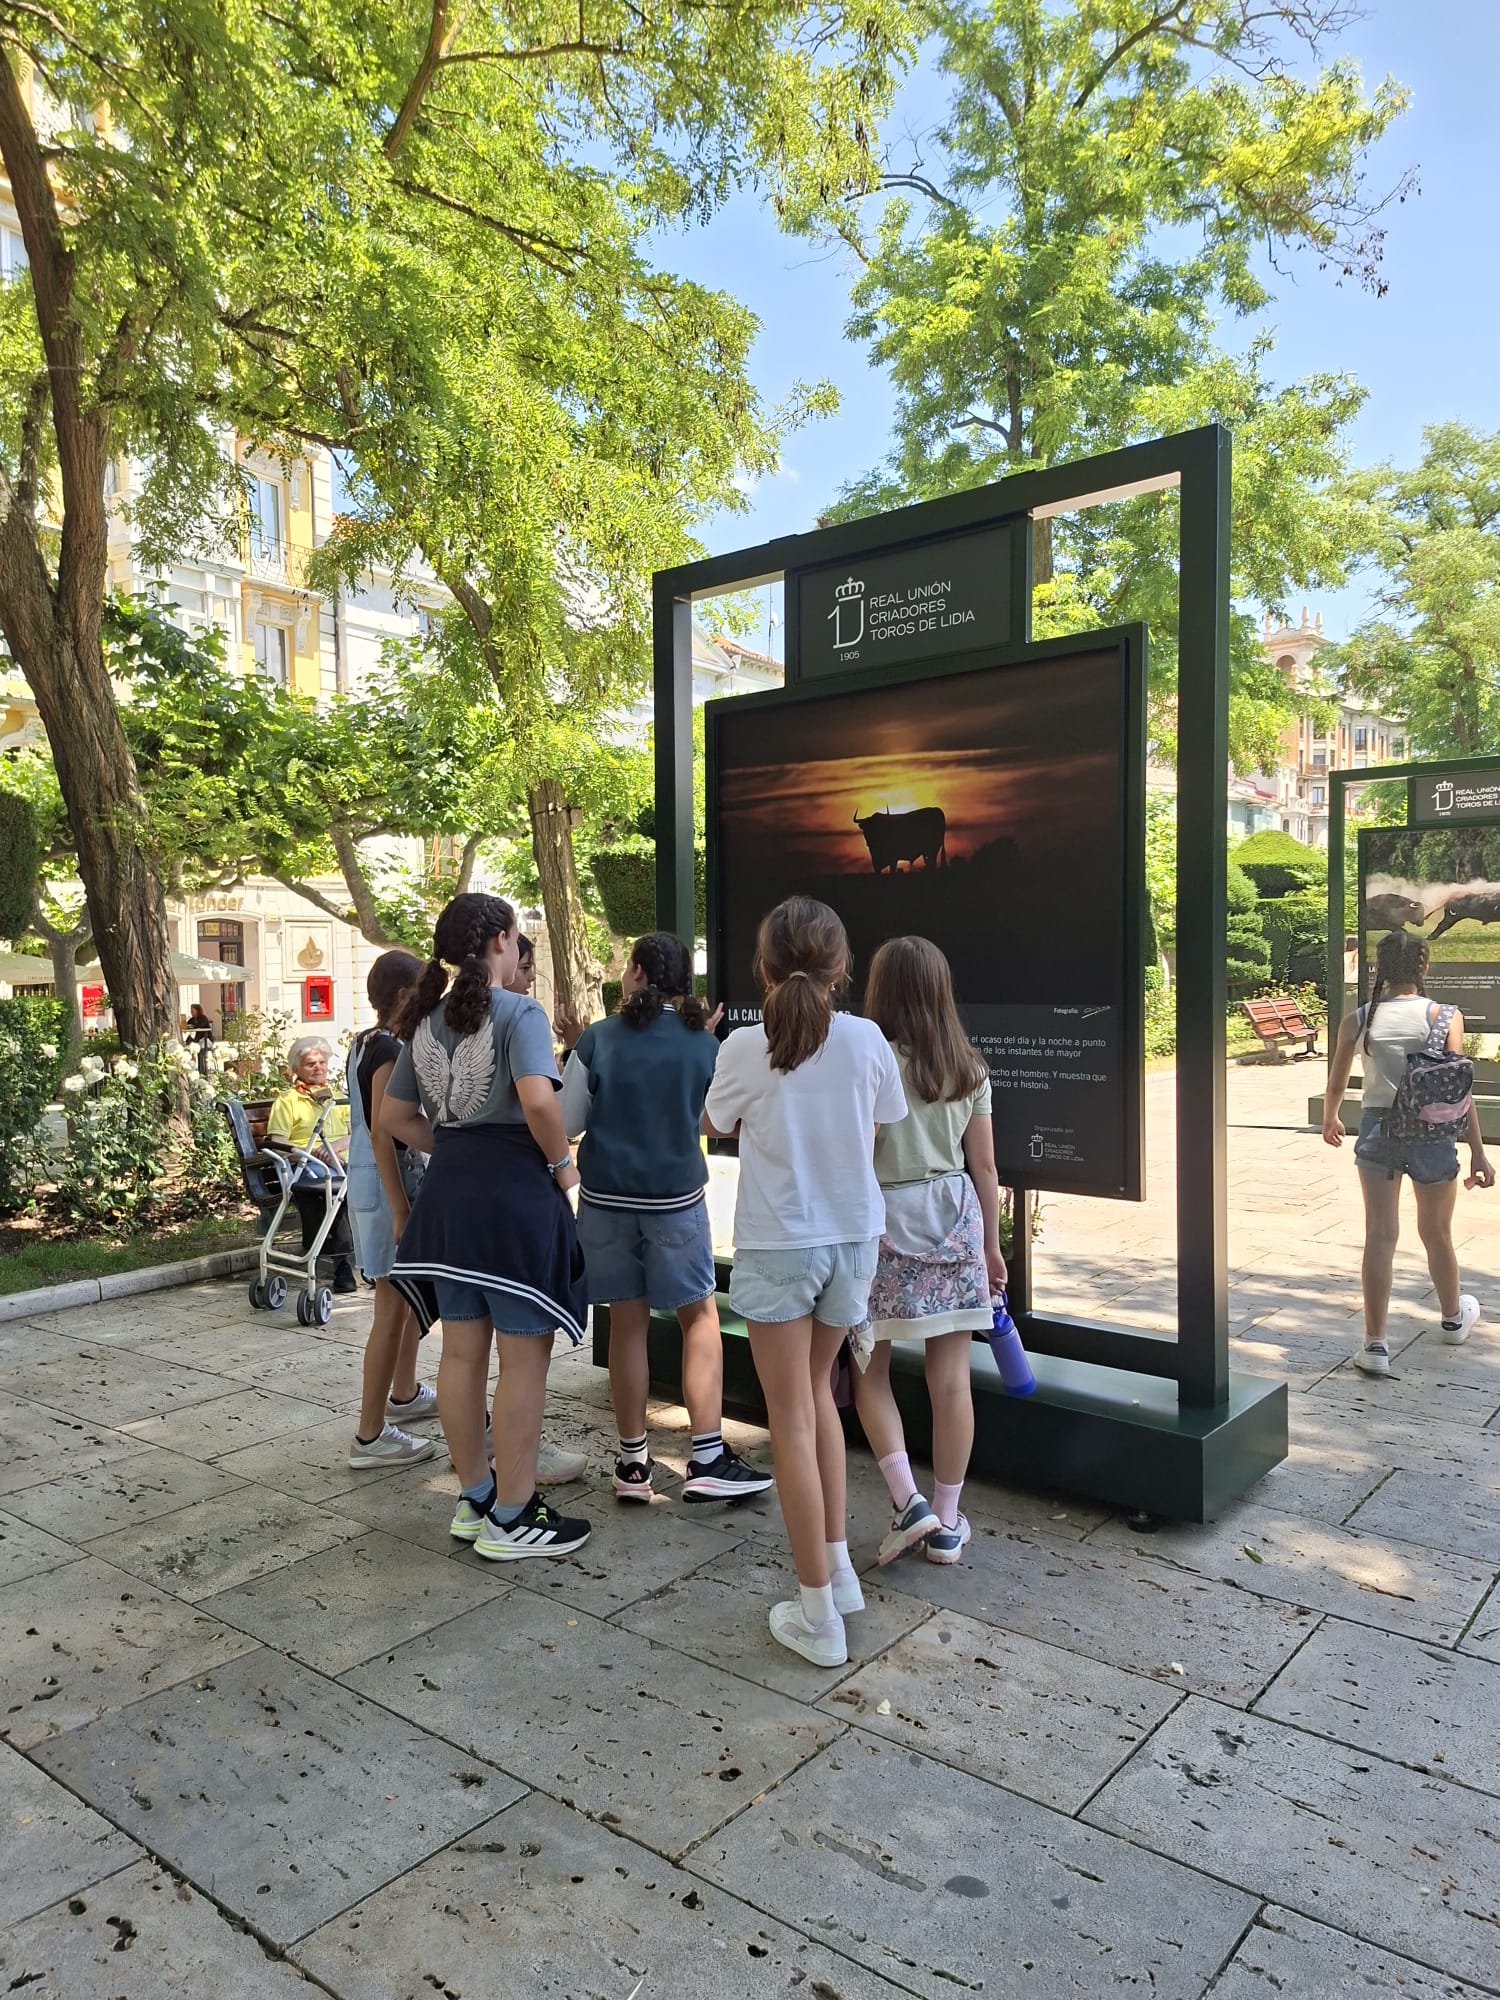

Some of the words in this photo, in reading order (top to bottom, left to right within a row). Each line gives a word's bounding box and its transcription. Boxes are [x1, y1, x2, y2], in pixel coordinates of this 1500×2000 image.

[869, 594, 904, 609] REAL
[907, 580, 951, 601] UNIÓN
[869, 599, 946, 625] CRIADORES
[869, 622, 916, 641] TOROS
[918, 617, 937, 632] DE
[940, 610, 976, 627] LIDIA
[839, 650, 860, 662] 1905
[1455, 793, 1498, 802] CRIADORES
[1455, 801, 1482, 809] TOROS
[728, 1008, 739, 1021] LA
[971, 1035, 978, 1043] el
[980, 1036, 1002, 1044] ocaso
[1003, 1036, 1015, 1044] del
[1031, 1038, 1037, 1047] y
[1038, 1037, 1046, 1045] la
[1048, 1037, 1073, 1046] noche
[1082, 1039, 1106, 1048] punto
[983, 1046, 993, 1054] de
[995, 1046, 1006, 1055] los
[1007, 1046, 1043, 1056] instantes
[1044, 1048, 1055, 1057] de
[1056, 1049, 1081, 1059] mayor
[1011, 1069, 1018, 1077] el
[1020, 1069, 1051, 1079] hombre.
[1052, 1070, 1058, 1079] Y
[1059, 1072, 1091, 1081] muestra
[1092, 1074, 1107, 1083] que
